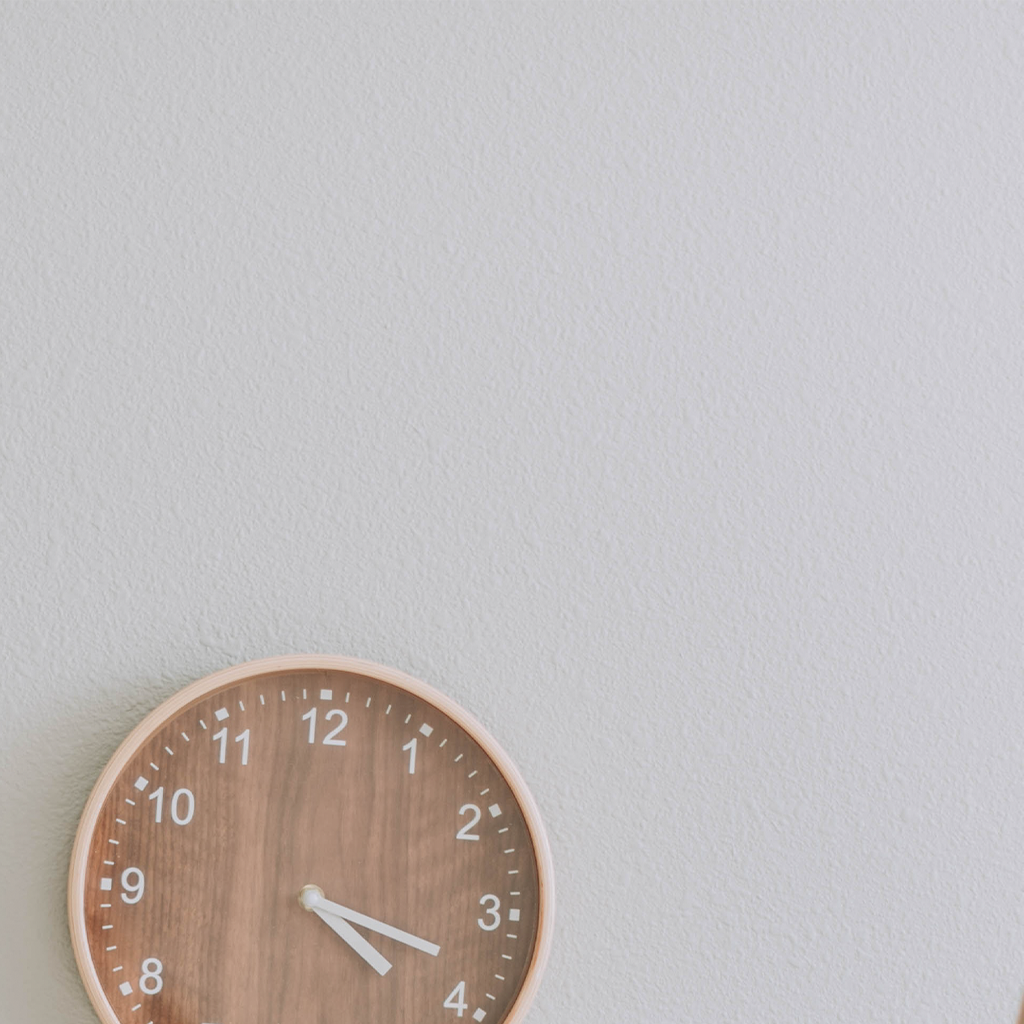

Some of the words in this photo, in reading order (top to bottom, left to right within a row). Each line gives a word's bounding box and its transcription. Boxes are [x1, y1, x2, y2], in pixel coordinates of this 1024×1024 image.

[302, 707, 348, 746] 12
[213, 727, 250, 765] 11
[402, 737, 418, 774] 1
[149, 786, 195, 825] 10
[456, 804, 481, 841] 2
[120, 867, 145, 904] 9
[477, 894, 502, 932] 3
[139, 958, 164, 995] 8
[443, 981, 468, 1017] 4
